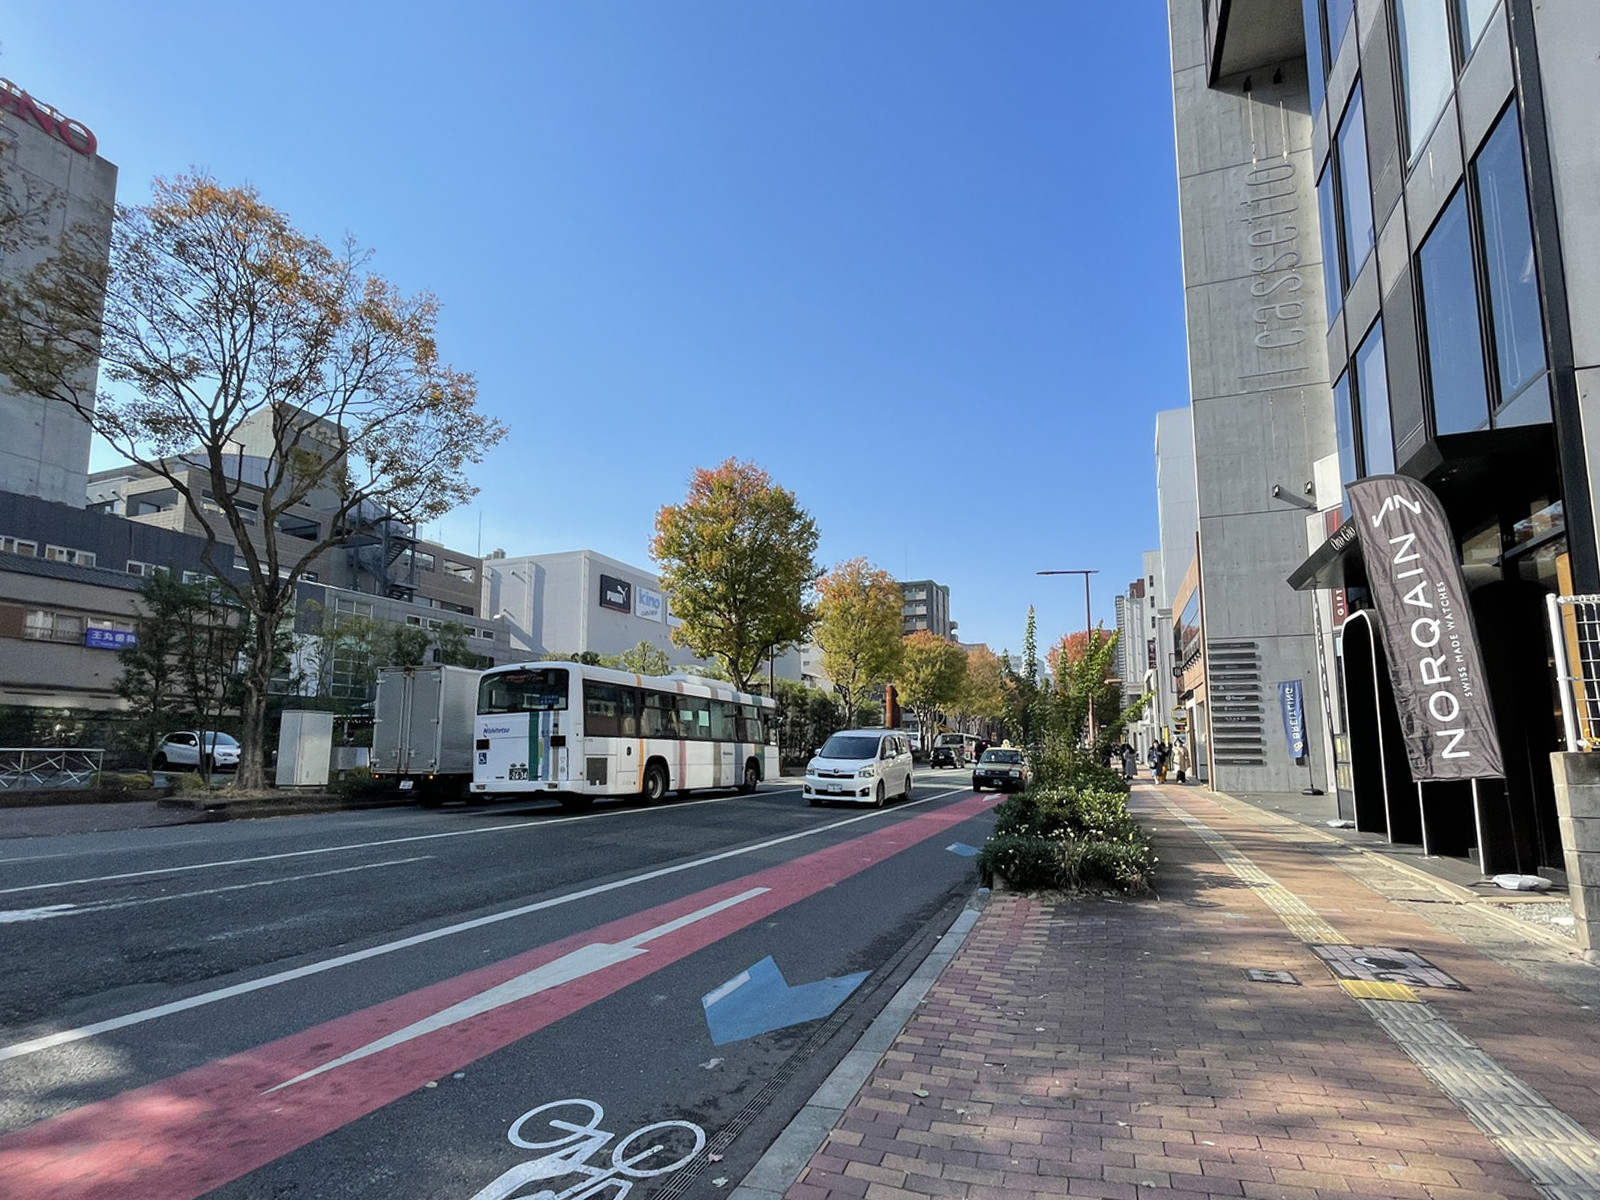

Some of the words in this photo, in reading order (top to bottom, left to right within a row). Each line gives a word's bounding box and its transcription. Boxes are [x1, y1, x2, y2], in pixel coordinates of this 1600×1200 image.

[1436, 581, 1456, 630] WATCHES
[1389, 532, 1470, 760] NORQAIN
[1449, 633, 1464, 662] MADE
[1457, 666, 1473, 697] SWISS
